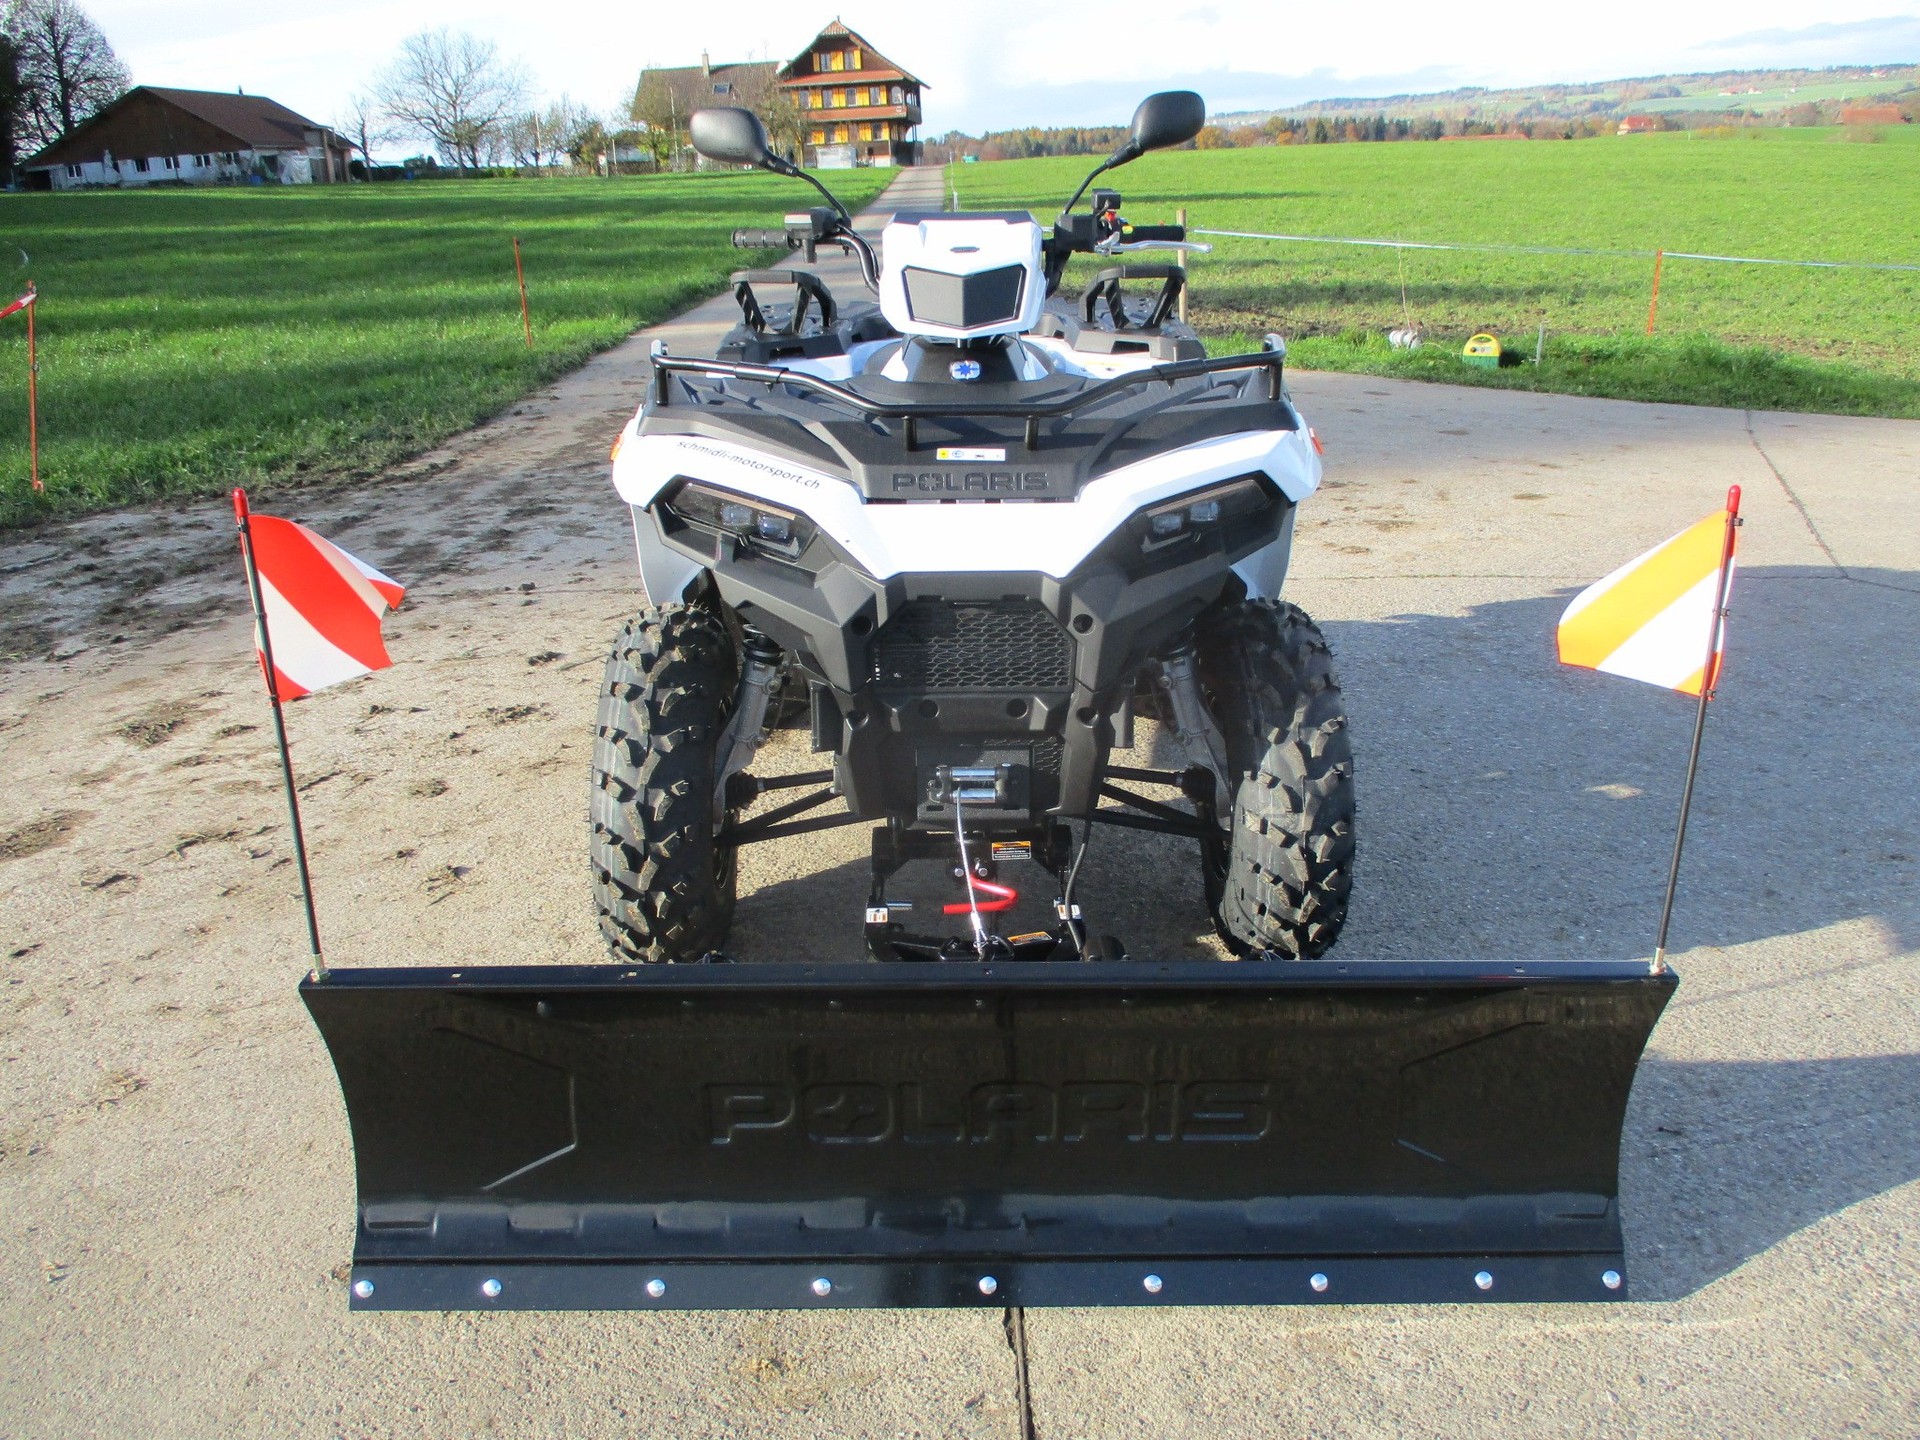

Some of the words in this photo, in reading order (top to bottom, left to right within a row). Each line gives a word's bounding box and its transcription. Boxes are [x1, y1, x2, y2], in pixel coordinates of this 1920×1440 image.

[677, 441, 820, 490] schmidli-motorsport.ch
[892, 471, 1049, 492] POLARIS
[703, 1082, 1273, 1146] POLARIS
